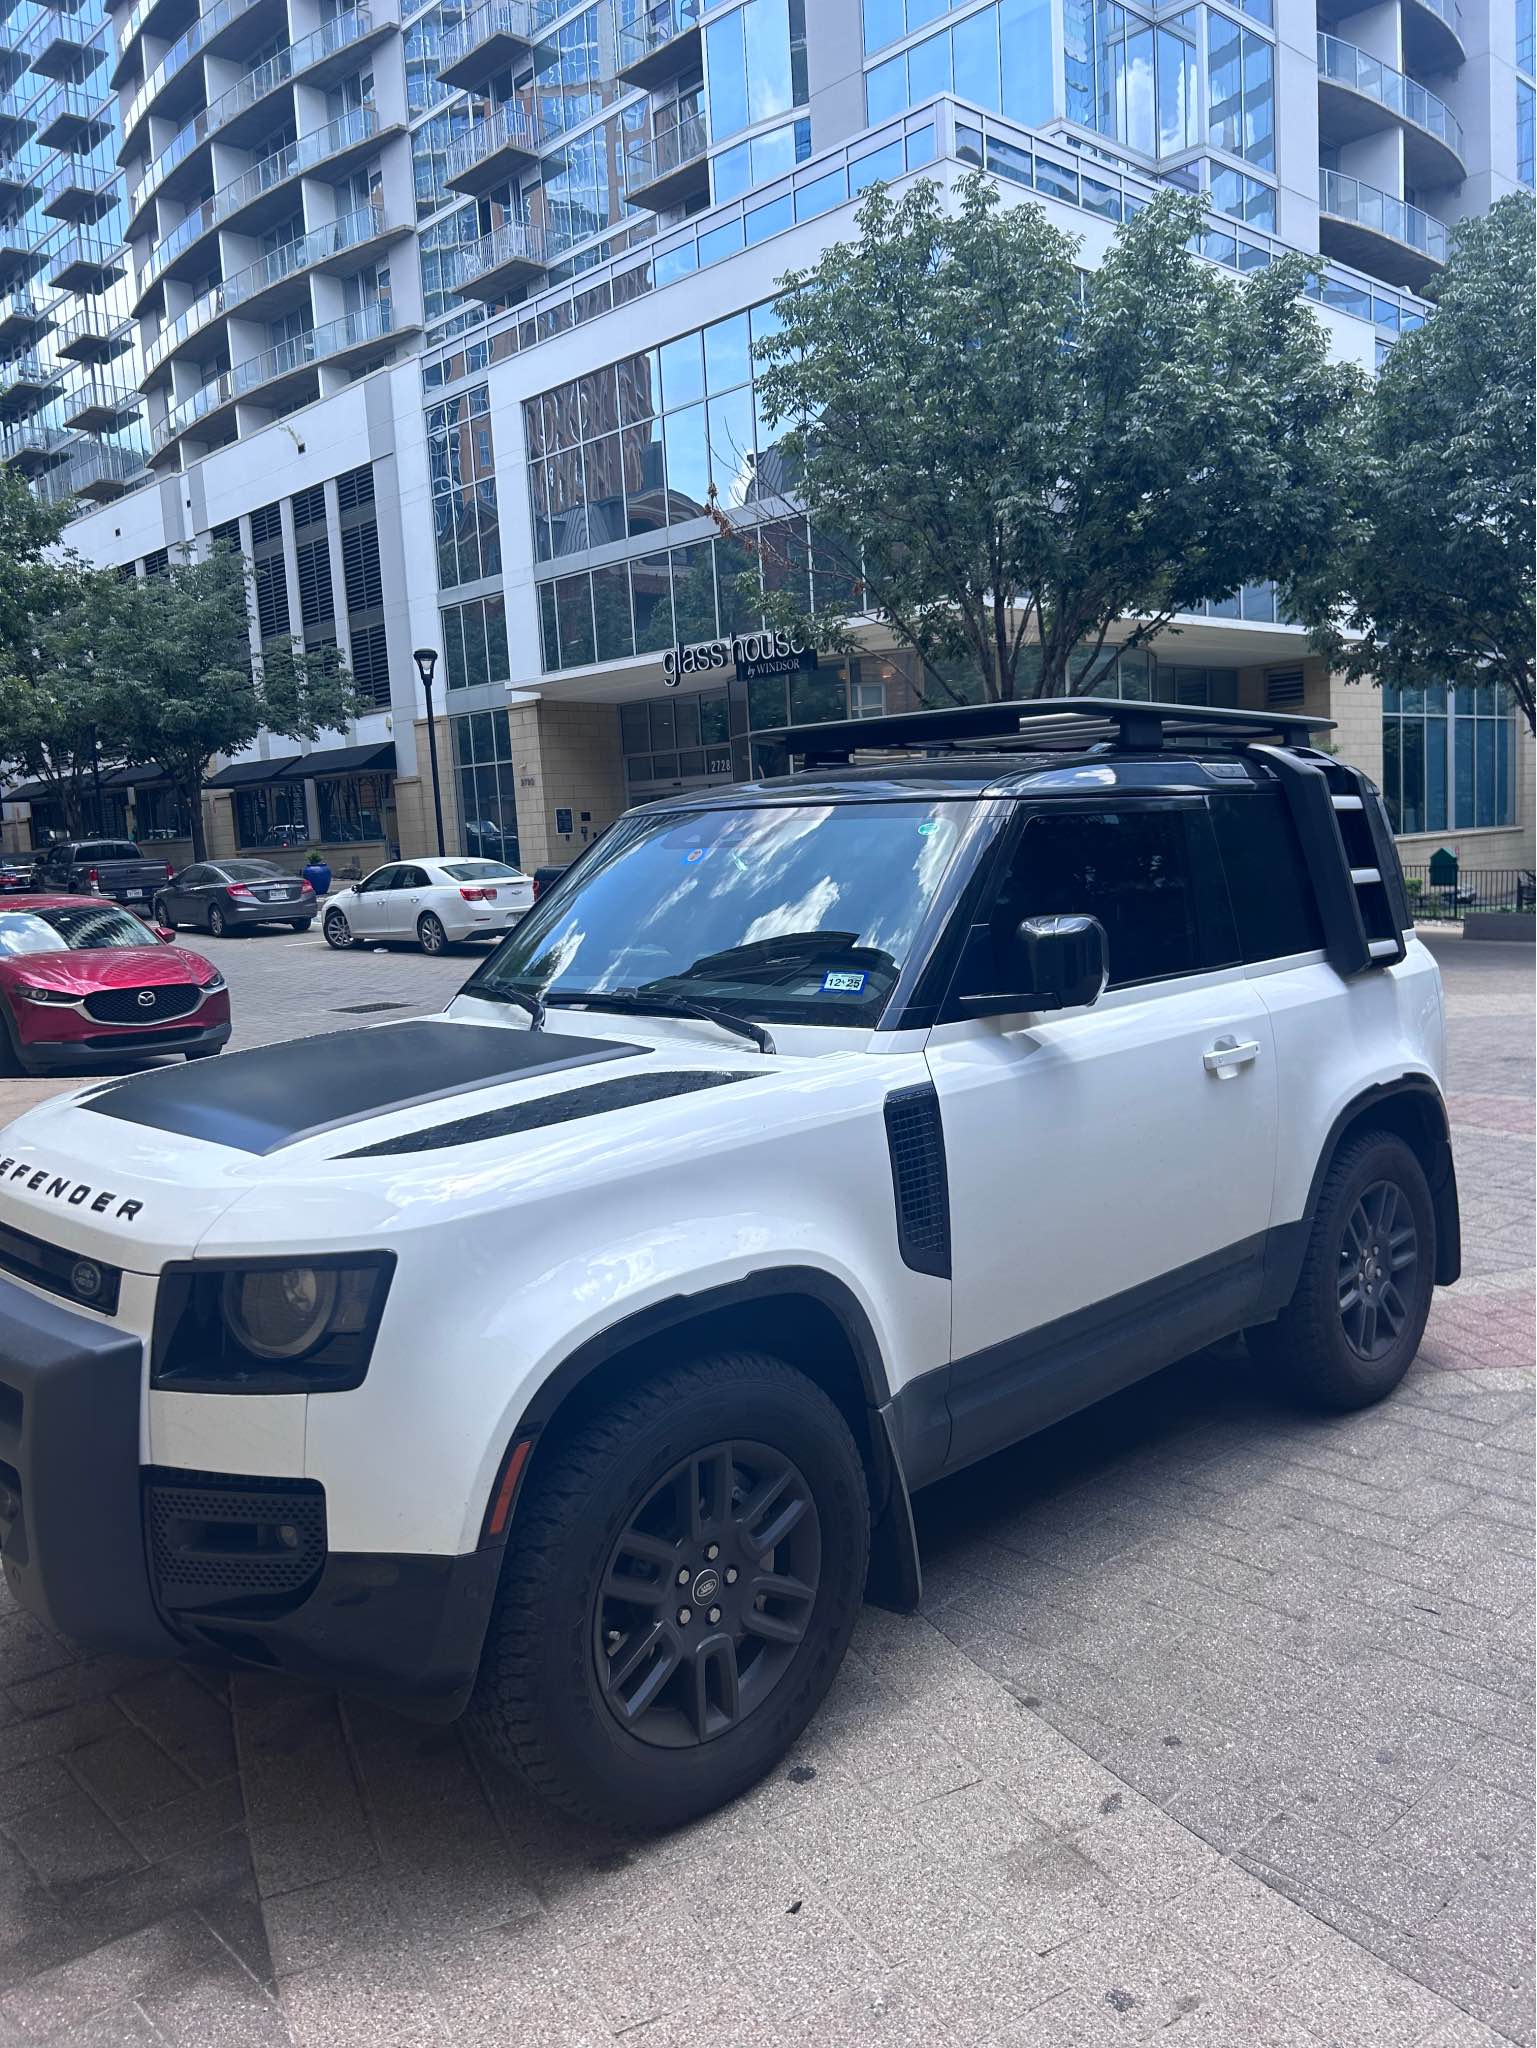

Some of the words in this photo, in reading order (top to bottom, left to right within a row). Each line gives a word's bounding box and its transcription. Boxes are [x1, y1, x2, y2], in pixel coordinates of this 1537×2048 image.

[663, 641, 725, 687] glass
[747, 664, 756, 678] by
[757, 658, 800, 674] WINDSOR
[711, 759, 731, 772] 2728
[0, 1157, 144, 1221] EFENDER
